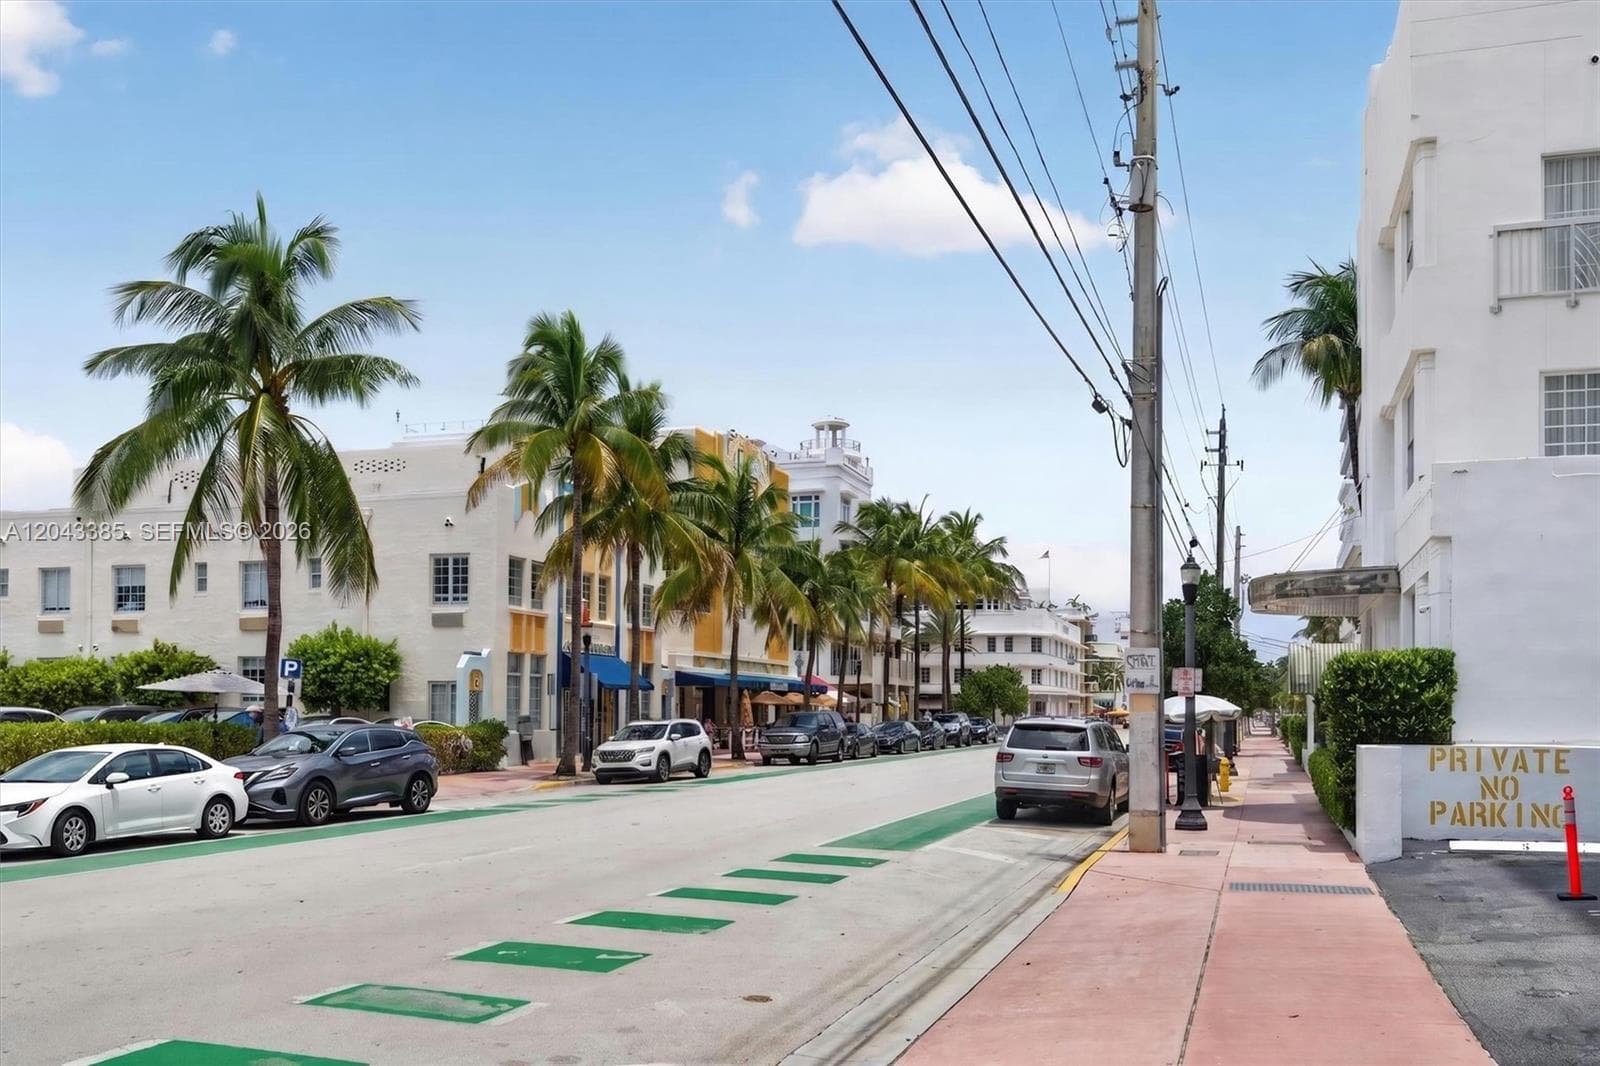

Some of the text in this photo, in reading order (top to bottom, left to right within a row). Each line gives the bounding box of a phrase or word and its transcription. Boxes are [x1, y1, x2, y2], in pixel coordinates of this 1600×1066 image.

[284, 661, 298, 676] P
[1429, 748, 1571, 774] PRIVATE
[1479, 775, 1520, 801] NO
